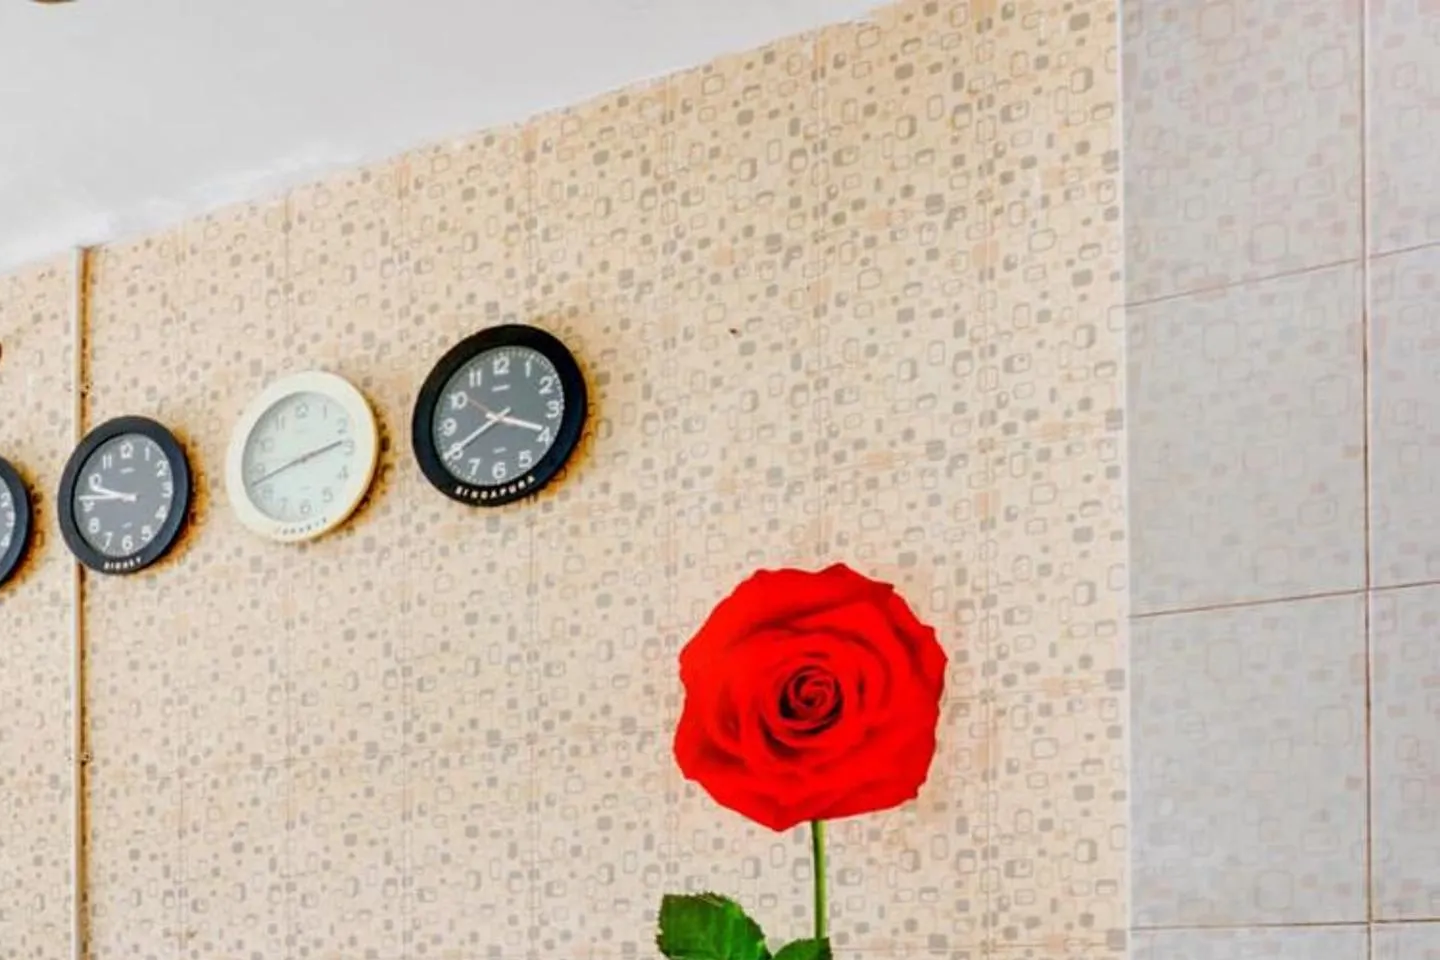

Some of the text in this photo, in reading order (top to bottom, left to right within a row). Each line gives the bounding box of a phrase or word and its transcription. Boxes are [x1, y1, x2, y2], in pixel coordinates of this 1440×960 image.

[493, 356, 509, 375] 12
[525, 361, 531, 377] 1
[469, 369, 482, 387] 11
[539, 376, 553, 394] 2
[451, 391, 467, 409] 10
[546, 401, 560, 418] 3
[442, 418, 457, 436] 9
[536, 426, 551, 445] 4
[102, 455, 113, 470] 11
[468, 458, 480, 475] 7
[519, 450, 532, 468] 5
[156, 461, 168, 477] 2
[492, 462, 506, 479] 6
[162, 482, 173, 498] 3
[155, 505, 167, 522] 4
[88, 517, 100, 534] 8
[141, 525, 152, 542] 5
[104, 532, 113, 549] 7
[122, 535, 133, 550] 6
